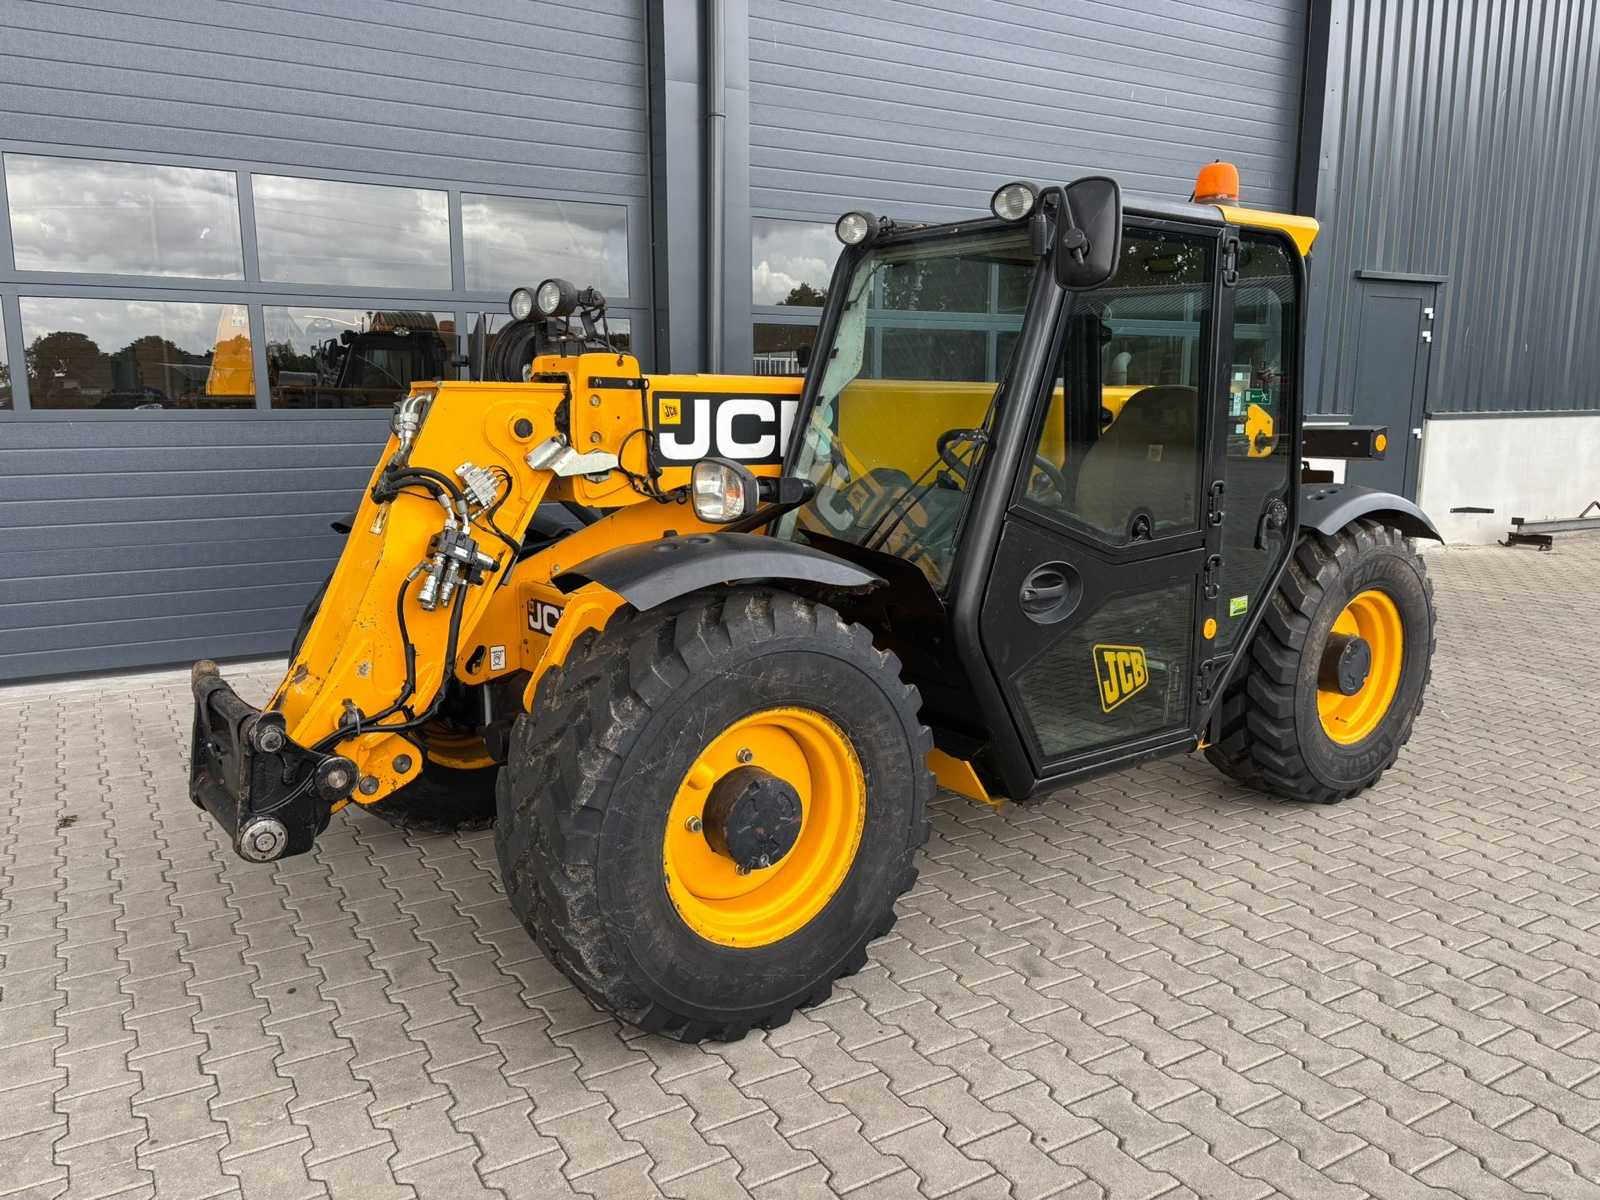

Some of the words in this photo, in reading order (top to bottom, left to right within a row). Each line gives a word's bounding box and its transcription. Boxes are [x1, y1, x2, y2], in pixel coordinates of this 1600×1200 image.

[659, 399, 800, 460] JC
[529, 602, 561, 634] JC
[1103, 651, 1146, 705] JCB
